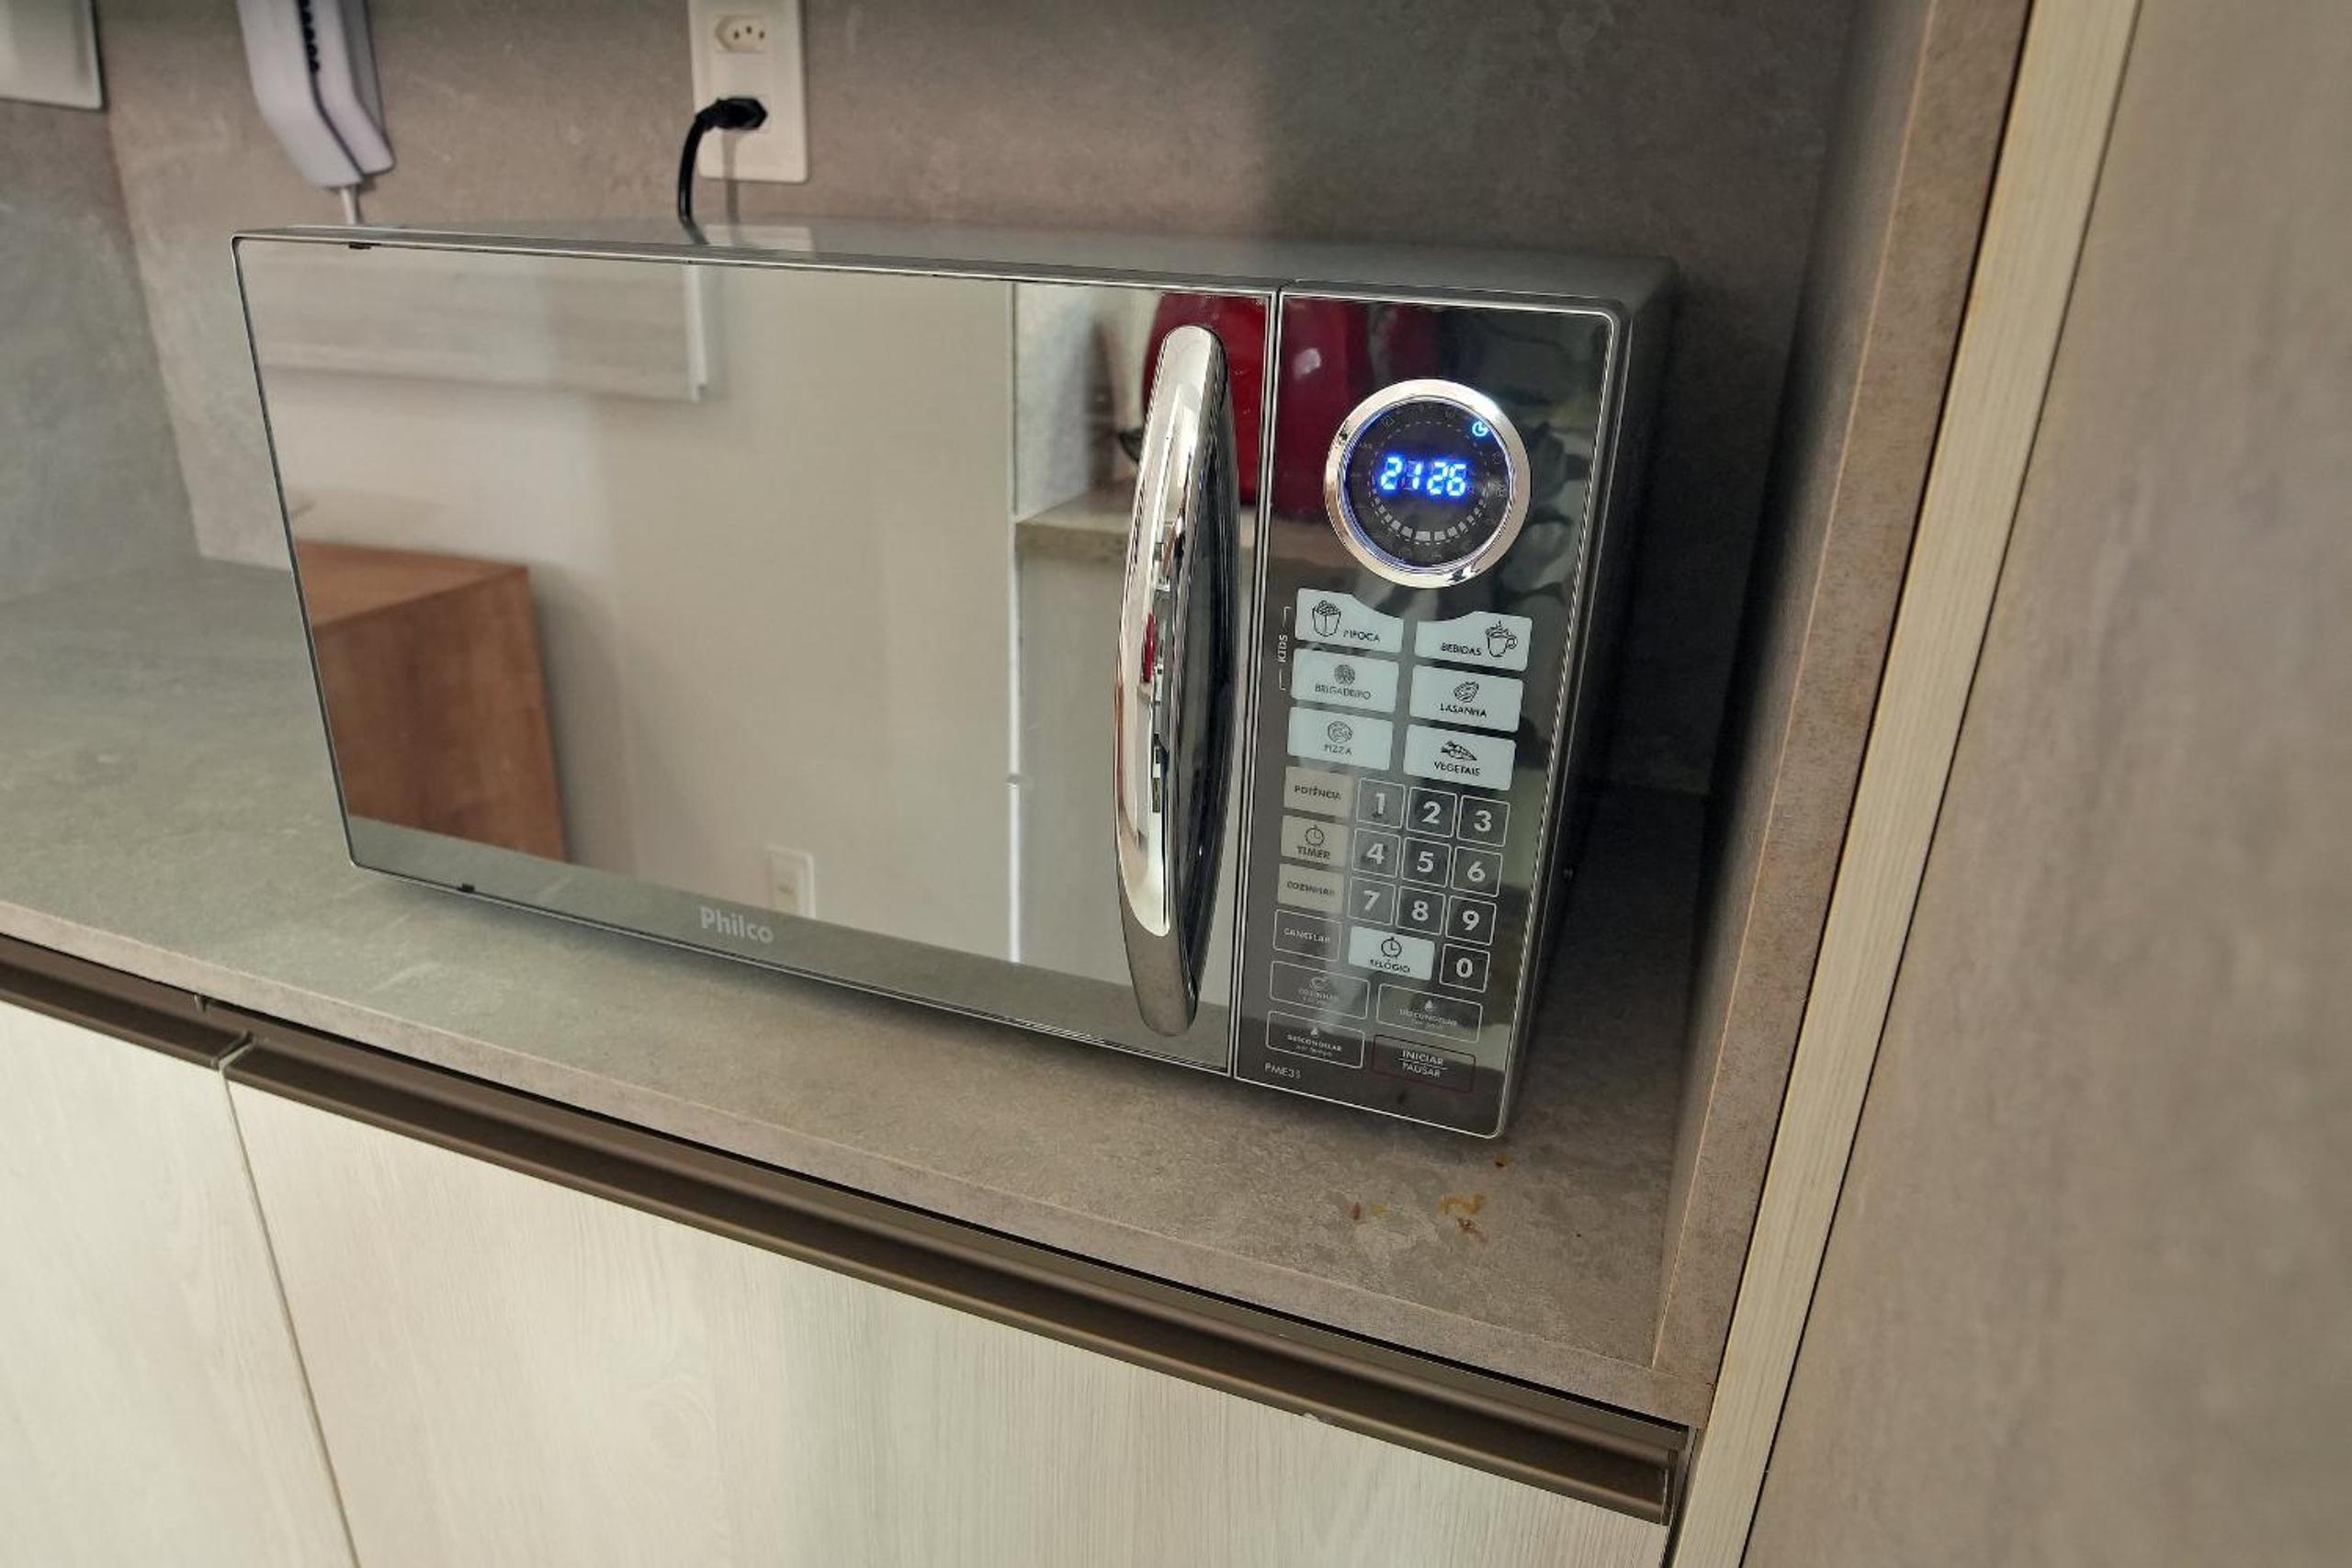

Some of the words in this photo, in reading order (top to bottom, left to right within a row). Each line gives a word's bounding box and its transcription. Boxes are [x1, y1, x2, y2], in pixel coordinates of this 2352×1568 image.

[1343, 629, 1380, 642] PIPOCA
[1278, 635, 1287, 662] KIDS
[1441, 642, 1482, 656] BEBIDAS
[1440, 704, 1487, 717] LASANHA
[1324, 744, 1352, 756] PIZZA
[1434, 761, 1480, 776] VEGETAIS
[1295, 784, 1340, 800] POTÊNCIA
[1375, 793, 1386, 815] 1
[1421, 801, 1442, 824] 2
[1474, 810, 1492, 832] 3
[1297, 846, 1330, 860] TIMER
[1365, 843, 1385, 865] 4
[1417, 852, 1434, 873] 5
[1467, 861, 1486, 883] 6
[1363, 890, 1381, 911] 7
[1411, 900, 1430, 921] 8
[700, 906, 774, 943] Philco
[1462, 910, 1480, 931] 9
[1283, 928, 1330, 943] CANCELAR
[1370, 959, 1410, 973] RELÓGIO
[1456, 957, 1474, 978] 0
[1402, 1050, 1443, 1066] INICIAR
[1402, 1063, 1441, 1077] PAUSAR
